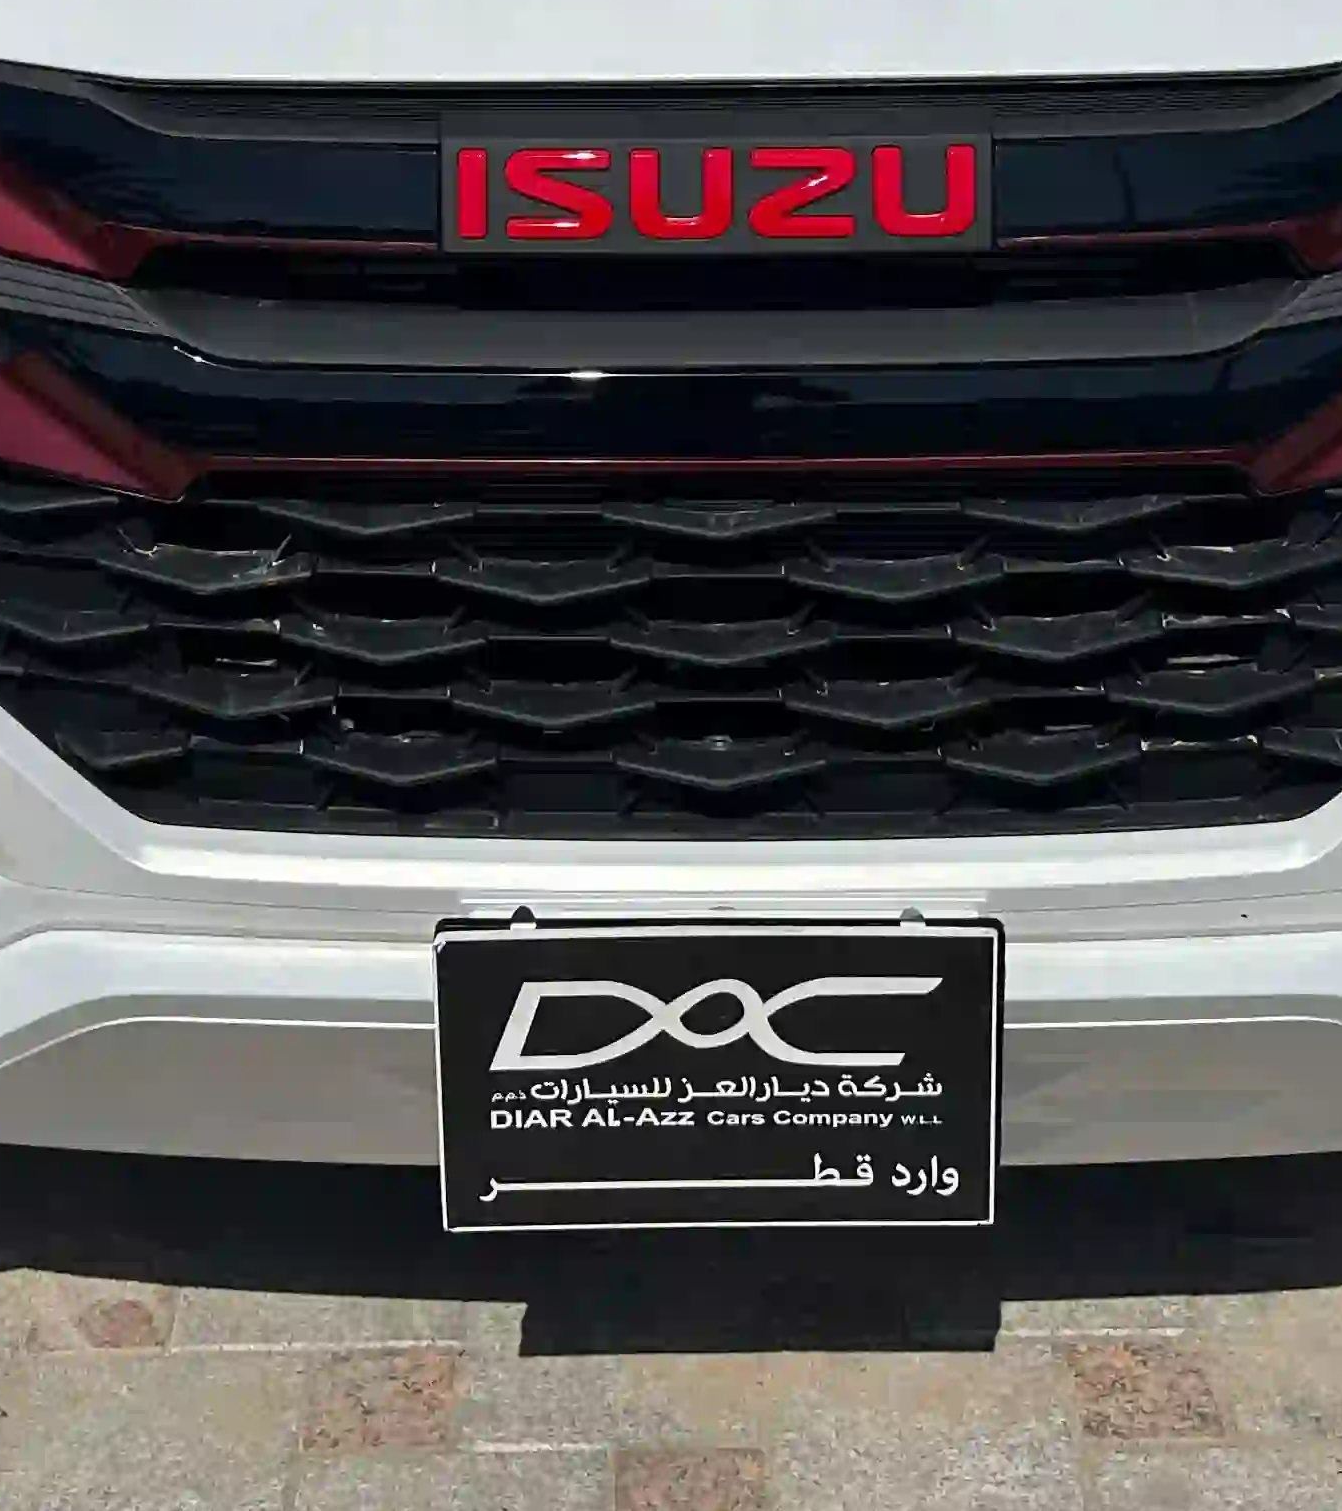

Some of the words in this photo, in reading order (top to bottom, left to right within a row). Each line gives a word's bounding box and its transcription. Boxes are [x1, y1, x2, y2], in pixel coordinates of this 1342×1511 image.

[455, 143, 977, 241] ISUZU
[529, 1076, 673, 1107] للسيارات
[676, 1074, 757, 1104] العز
[754, 1074, 831, 1104] ديار
[836, 1071, 944, 1103] شركة
[489, 1107, 575, 1131] DIAR
[705, 1109, 767, 1127] Cars
[771, 1109, 895, 1129] Company
[890, 1153, 961, 1198] وارد
